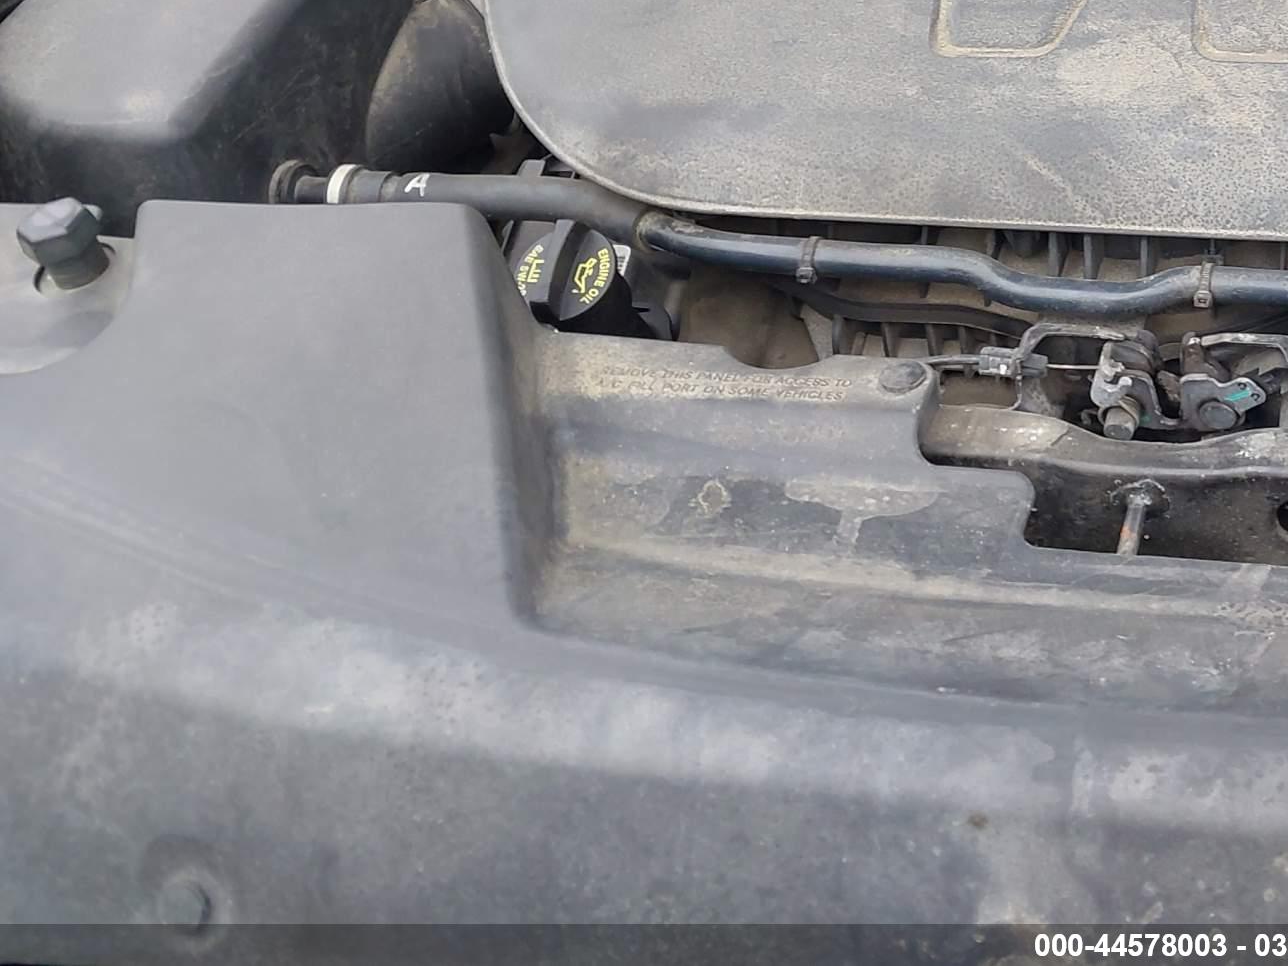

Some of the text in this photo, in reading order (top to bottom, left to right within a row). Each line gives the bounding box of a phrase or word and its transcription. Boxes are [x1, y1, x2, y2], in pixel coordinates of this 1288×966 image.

[579, 248, 610, 304] ENGINE OIL
[661, 367, 693, 380] THIS
[695, 370, 740, 383] PANEL
[774, 376, 831, 388] ACCESS
[834, 378, 853, 388] TO
[662, 382, 700, 393] PORT
[703, 385, 726, 395] ON
[727, 385, 769, 396] SOME
[774, 388, 844, 401] VEHICLES
